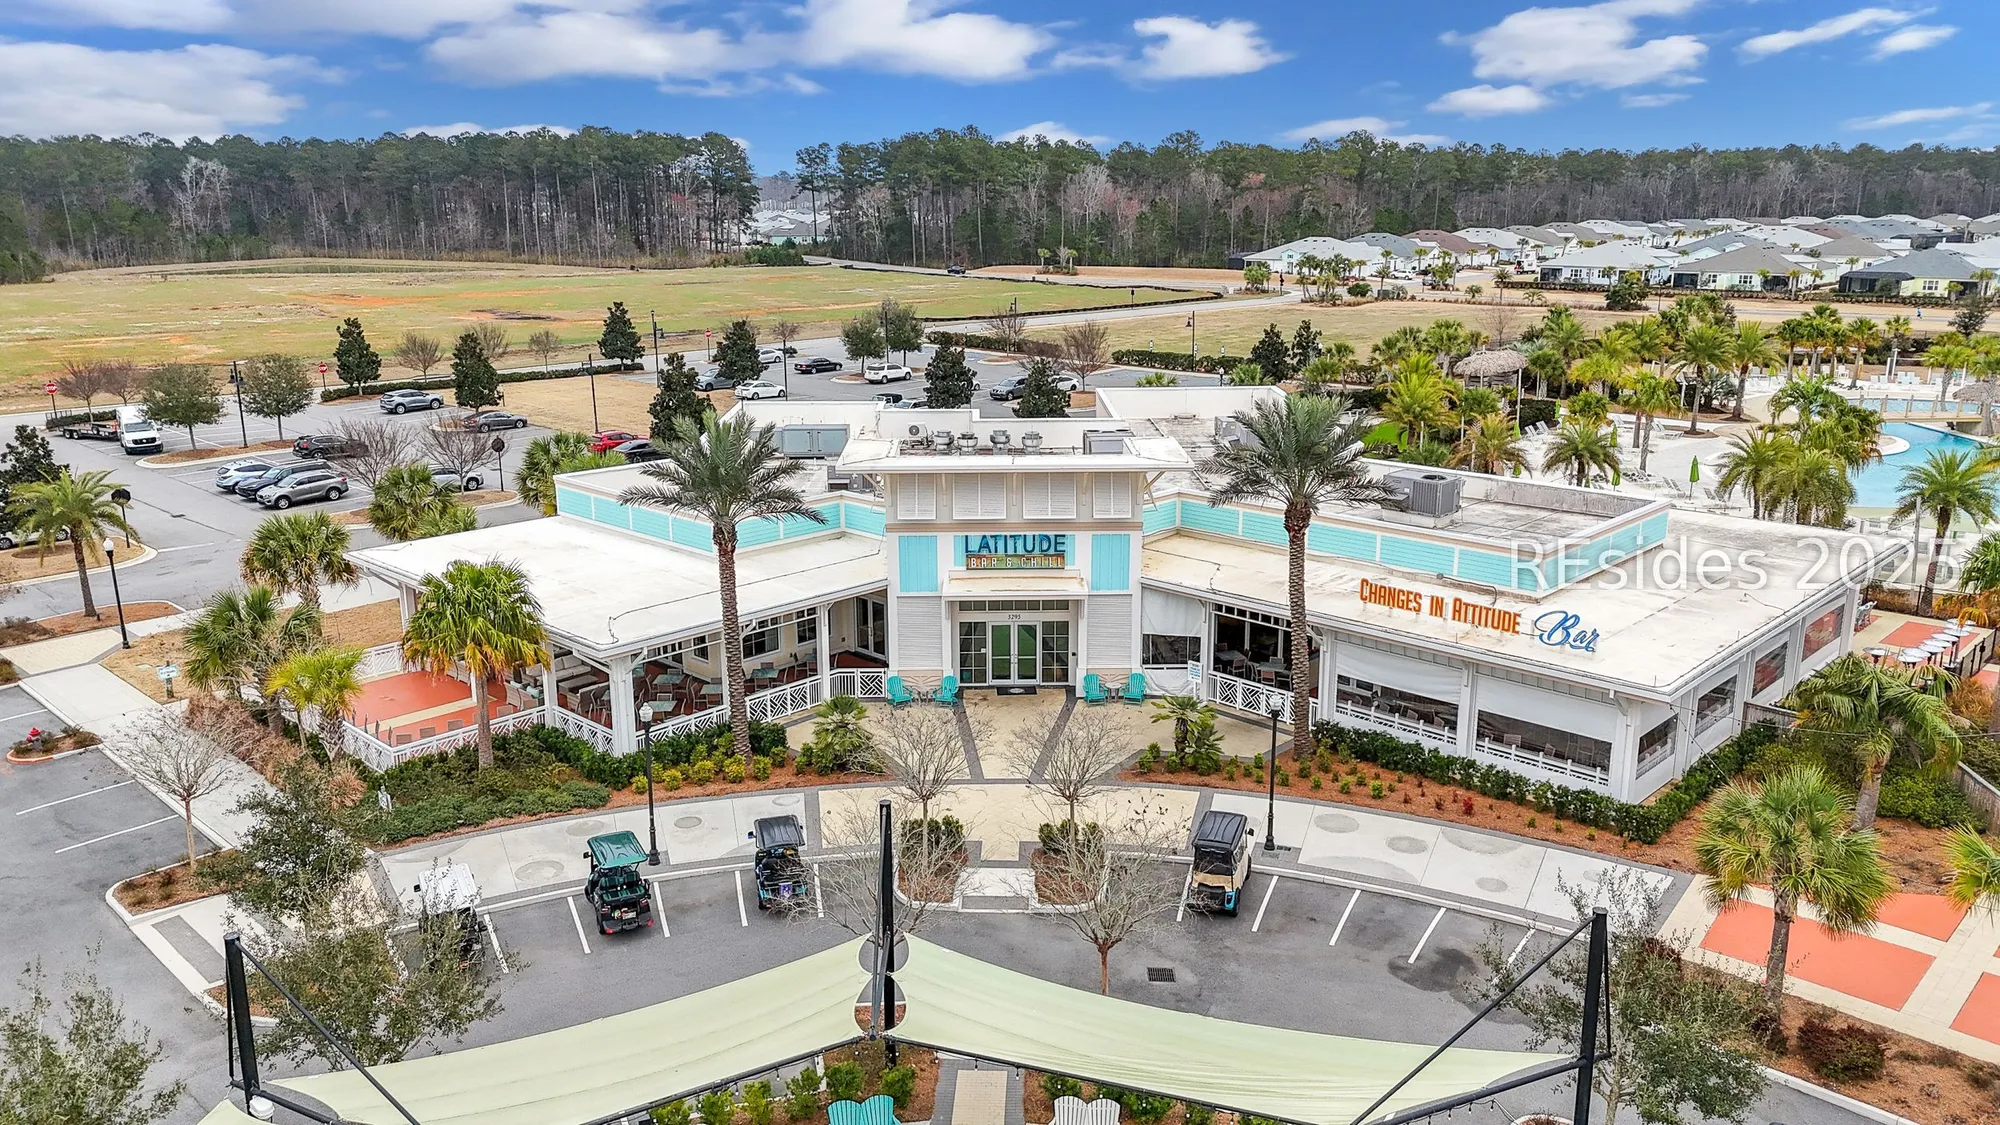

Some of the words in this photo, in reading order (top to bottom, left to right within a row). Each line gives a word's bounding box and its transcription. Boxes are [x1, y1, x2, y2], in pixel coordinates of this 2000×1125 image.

[965, 534, 1066, 553] LATITUDE
[970, 557, 997, 568] BAR
[1006, 557, 1012, 568] &
[1021, 557, 1062, 568] CHILL
[1359, 578, 1422, 613] CHANGES
[1429, 594, 1444, 618] IN
[1452, 597, 1522, 635] ATTITUDE
[1534, 610, 1600, 653] Bar
